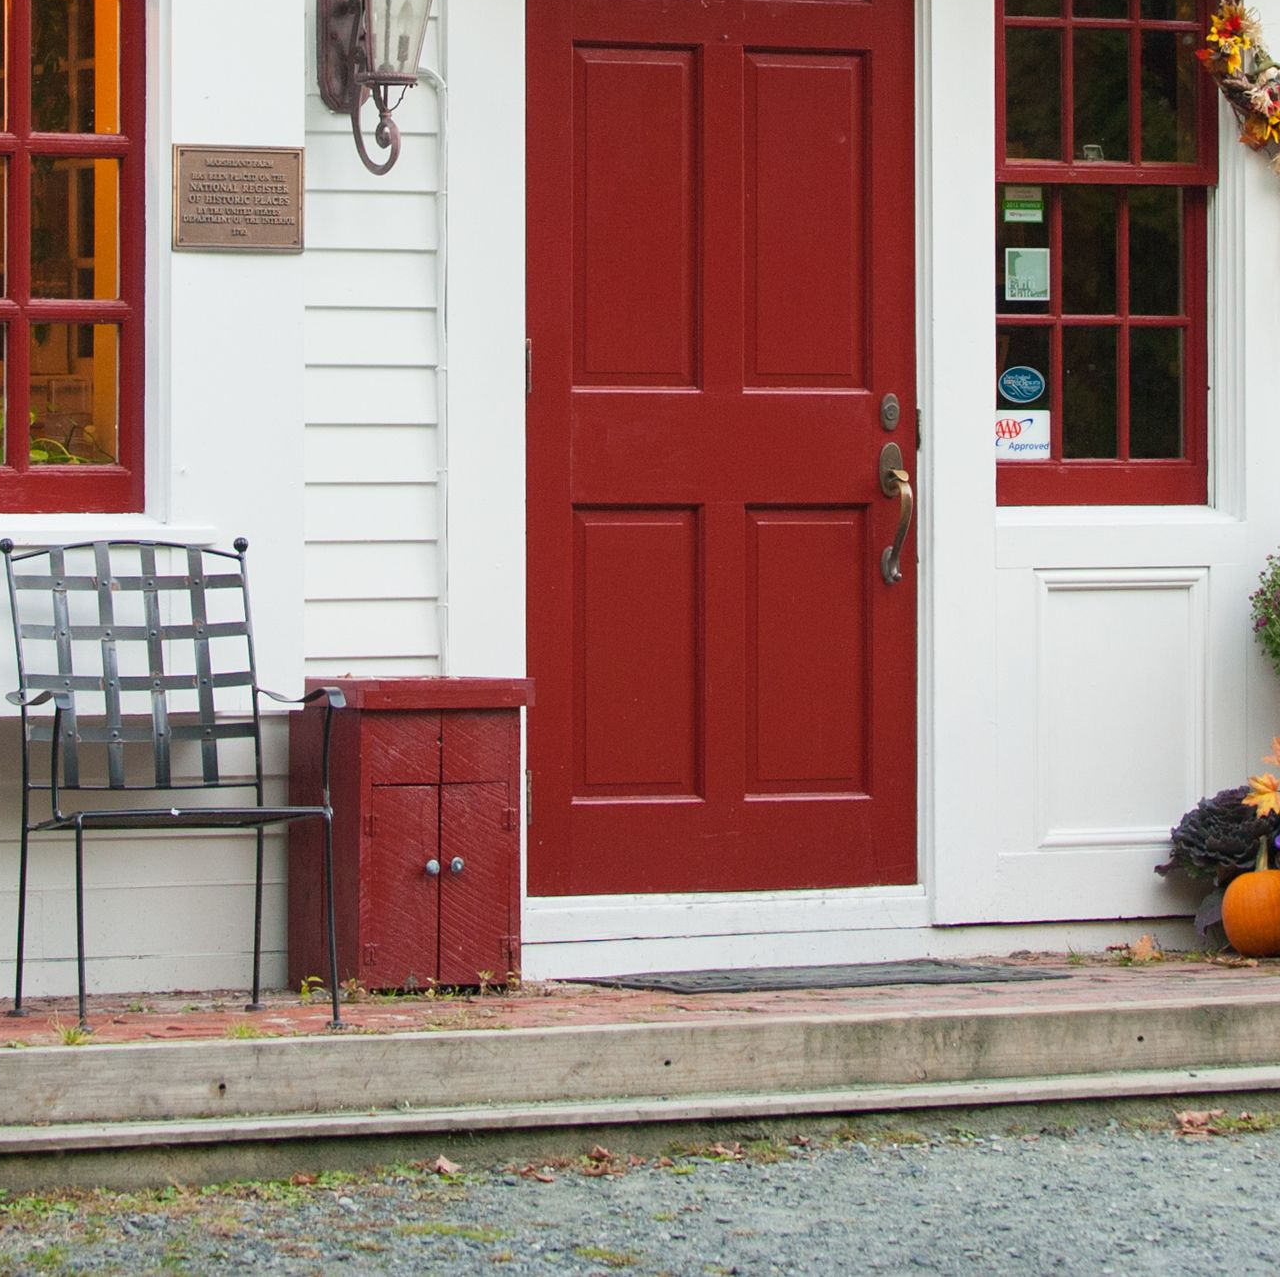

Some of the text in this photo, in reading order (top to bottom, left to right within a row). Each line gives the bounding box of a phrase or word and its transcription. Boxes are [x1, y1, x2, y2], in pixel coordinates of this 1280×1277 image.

[189, 182, 289, 194] NATIONAL REGISTER
[188, 194, 290, 206] OF HISTORIC PLACES
[996, 420, 1021, 438] AAA
[1008, 441, 1049, 452] Approved
